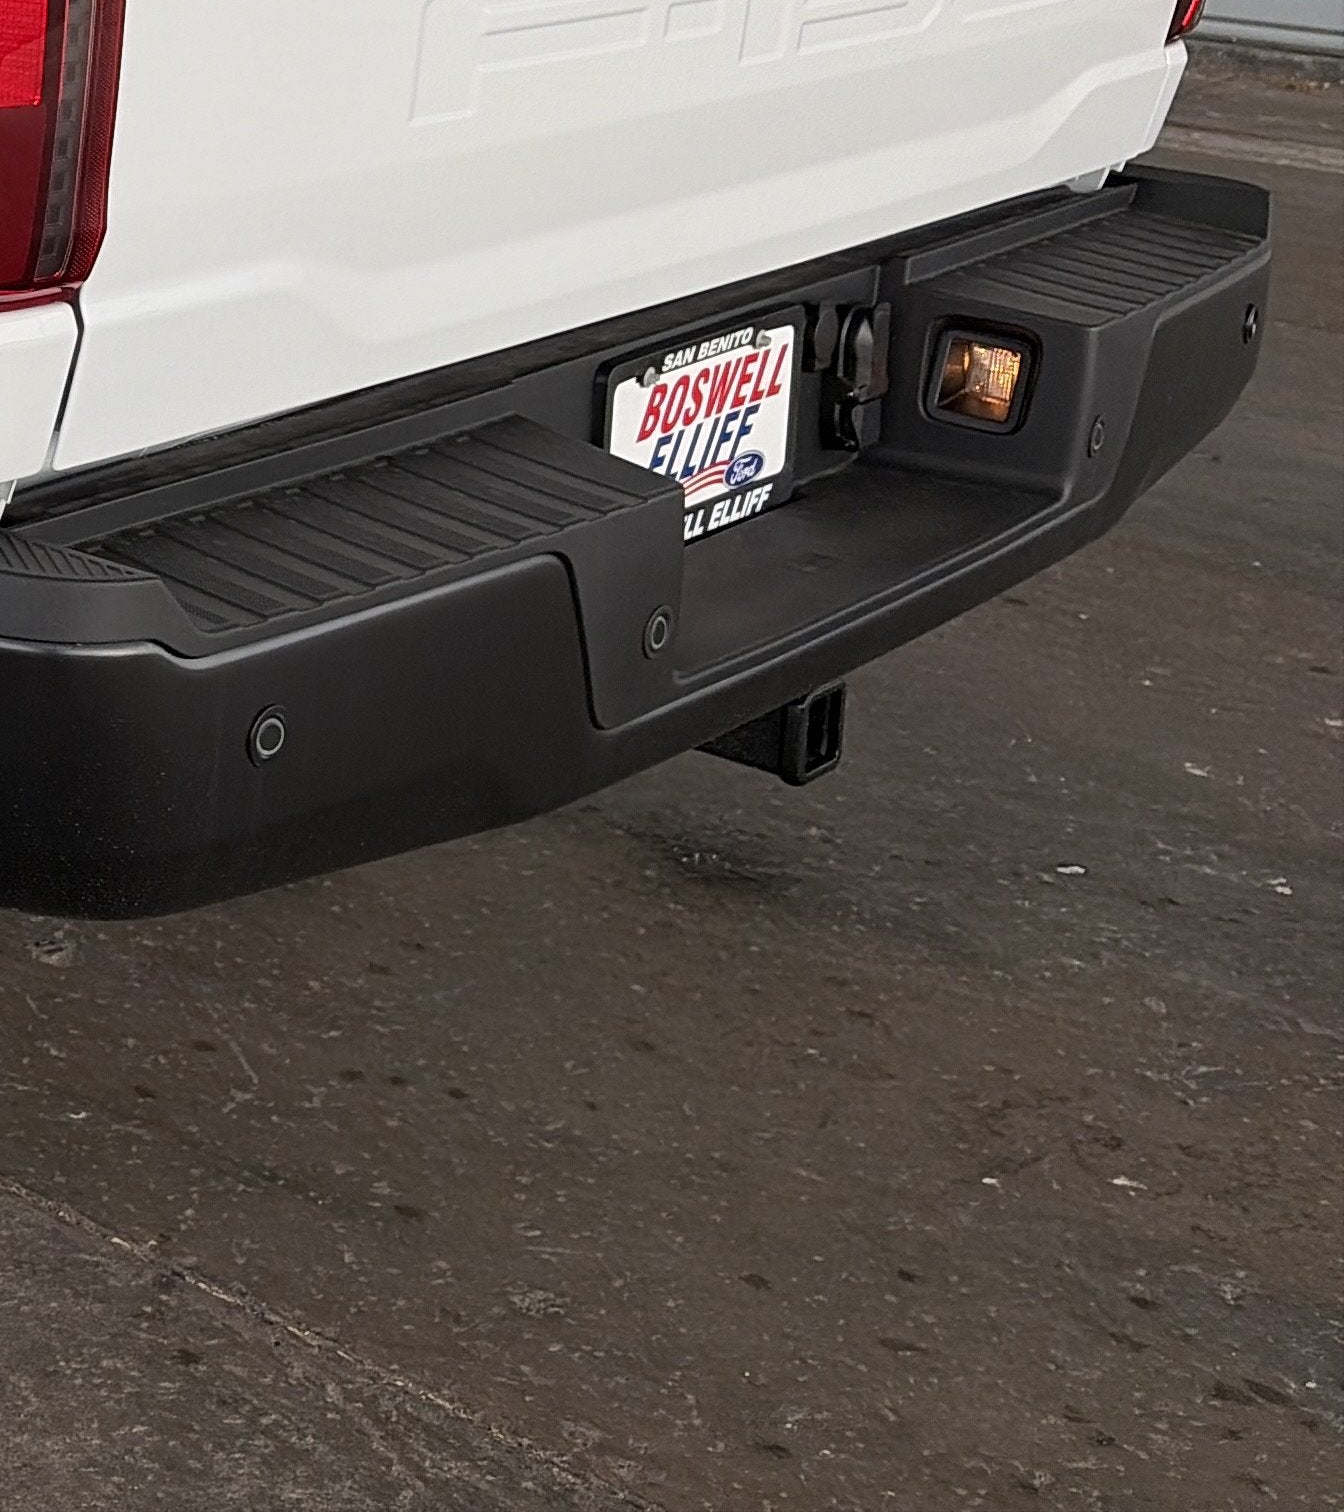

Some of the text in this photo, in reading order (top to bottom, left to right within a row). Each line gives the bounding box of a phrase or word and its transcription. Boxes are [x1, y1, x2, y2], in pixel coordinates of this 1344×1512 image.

[662, 326, 755, 372] SAN BENITO
[635, 343, 789, 444] BOSWELL
[648, 402, 762, 482] ELLIFF
[728, 454, 761, 486] Ford
[707, 483, 774, 532] ELLIFF
